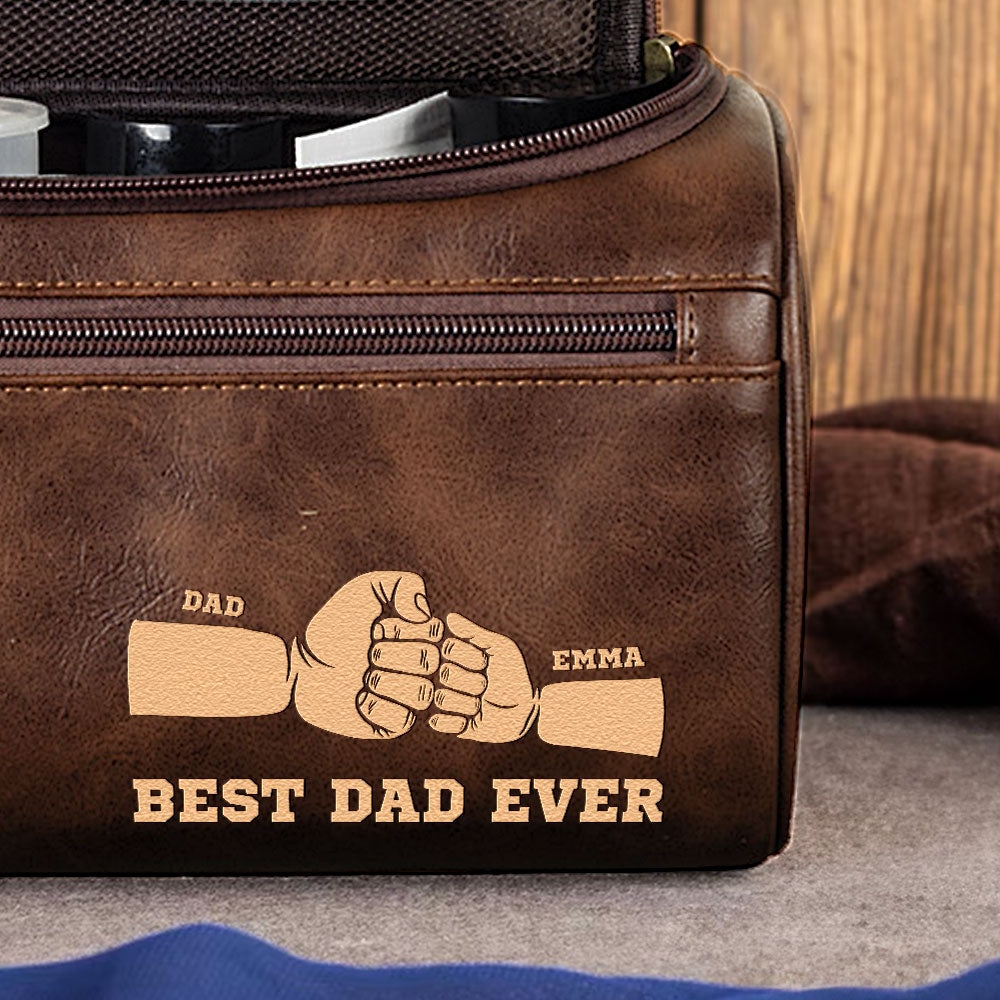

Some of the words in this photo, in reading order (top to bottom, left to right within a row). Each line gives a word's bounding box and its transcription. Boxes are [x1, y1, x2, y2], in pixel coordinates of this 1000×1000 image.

[182, 589, 246, 618] DAD
[552, 646, 645, 671] EMMA
[133, 779, 304, 822] BEST
[331, 779, 463, 822] DAD
[492, 779, 662, 822] EVER
